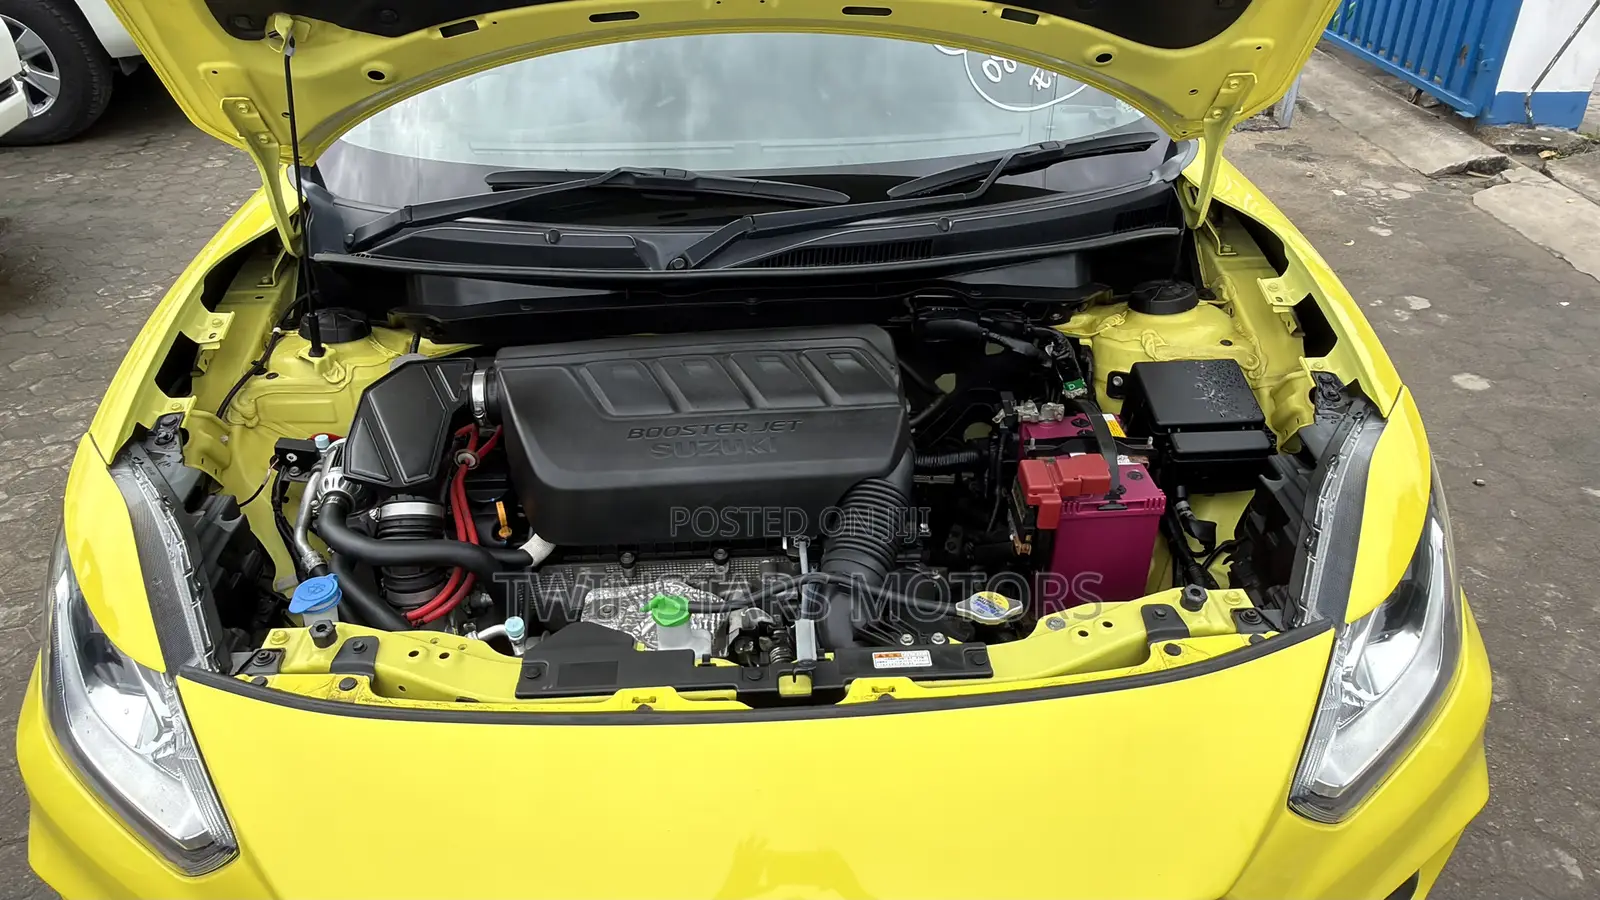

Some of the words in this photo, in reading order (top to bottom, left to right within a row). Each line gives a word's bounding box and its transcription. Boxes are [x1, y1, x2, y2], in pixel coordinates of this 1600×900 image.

[627, 422, 747, 440] BOOSTER
[751, 419, 803, 435] JET
[650, 437, 779, 459] SUZUKI
